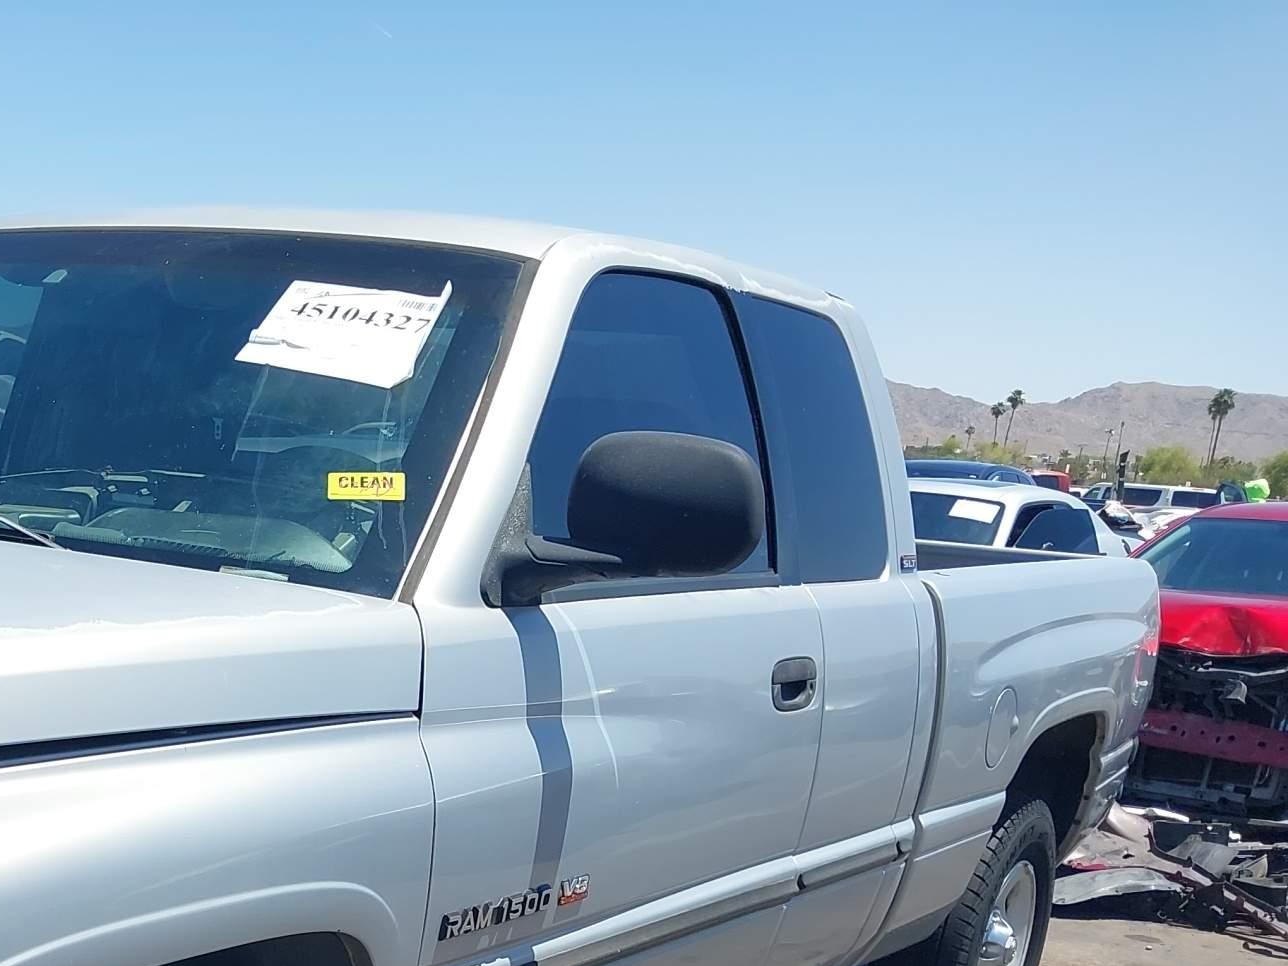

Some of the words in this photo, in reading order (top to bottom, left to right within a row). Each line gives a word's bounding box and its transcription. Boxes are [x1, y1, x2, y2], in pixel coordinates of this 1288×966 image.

[290, 301, 432, 334] 45104327
[338, 476, 394, 489] CLEAN
[903, 559, 917, 568] SLT
[441, 905, 495, 940] RAM
[493, 889, 552, 925] 1500
[561, 875, 590, 897] V8
